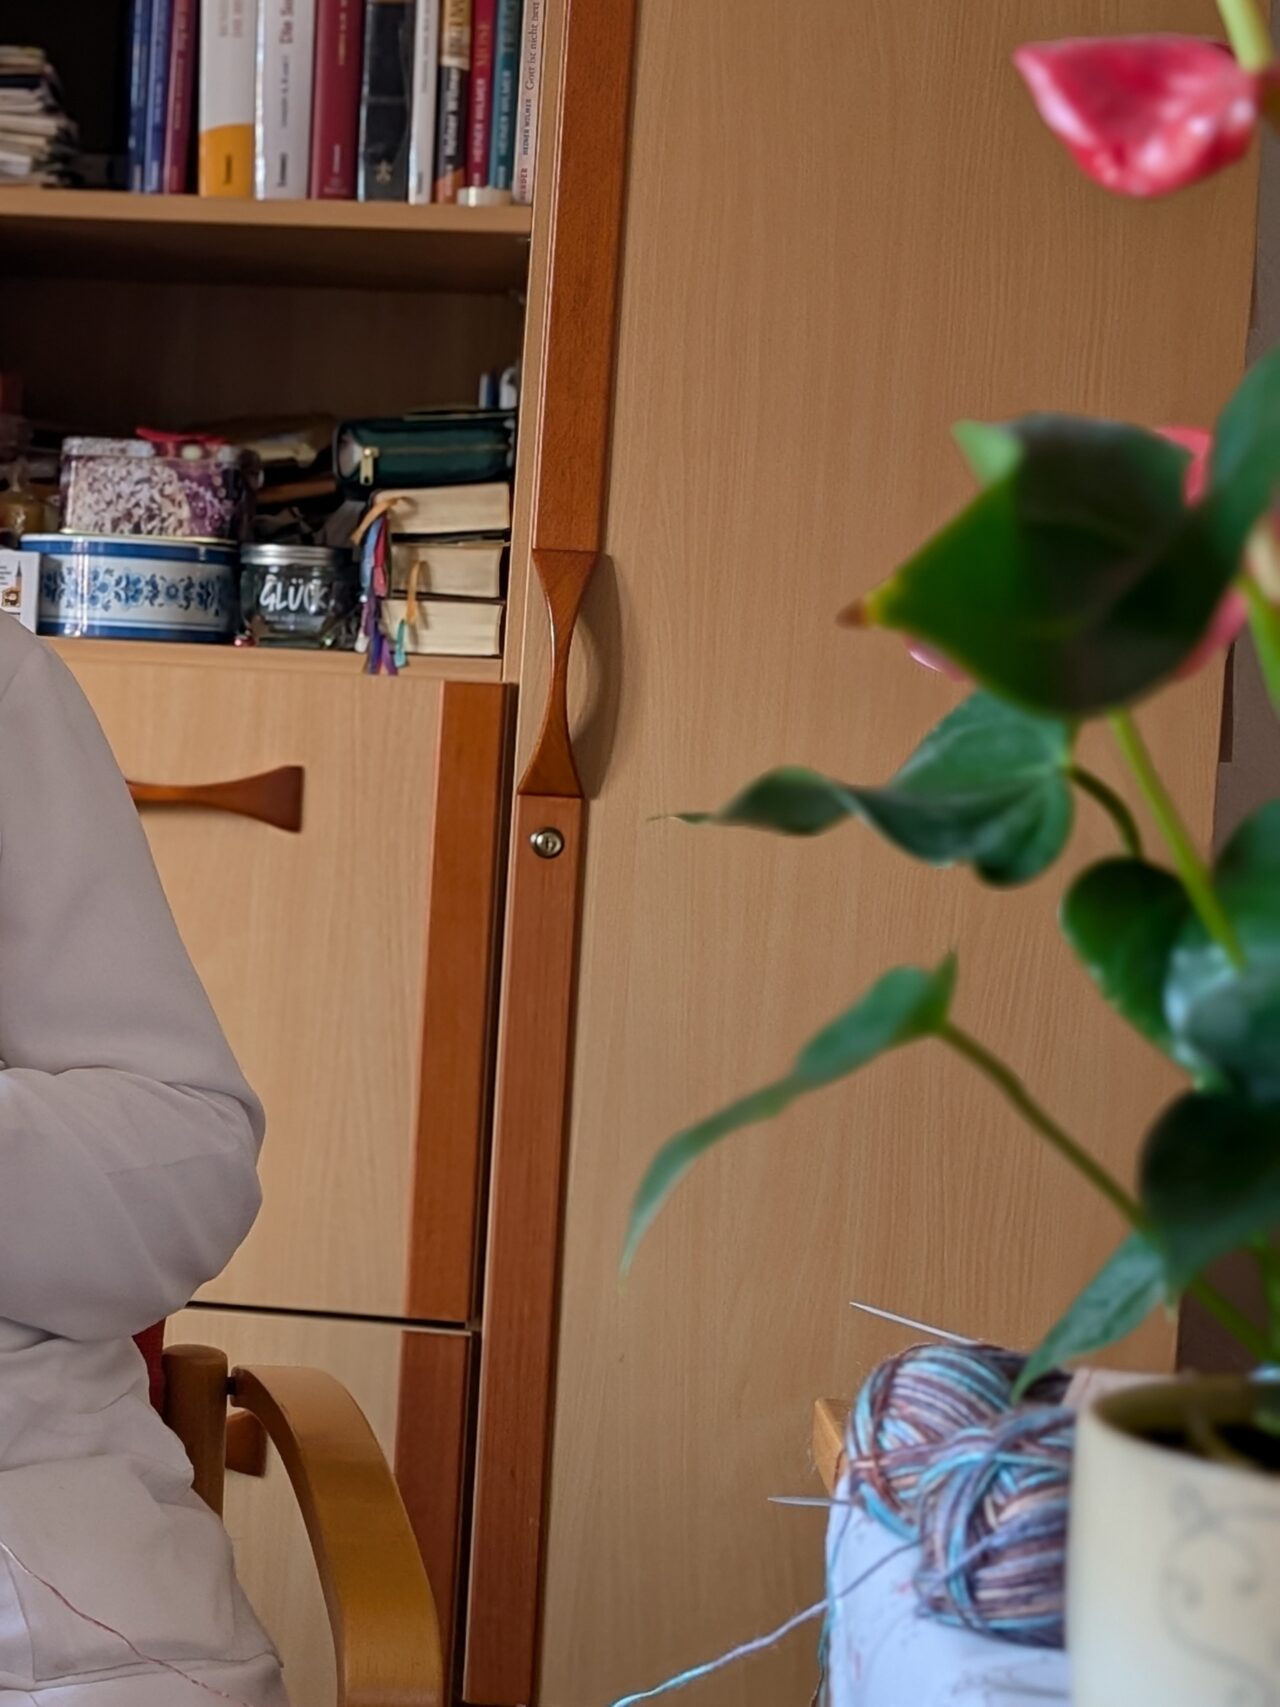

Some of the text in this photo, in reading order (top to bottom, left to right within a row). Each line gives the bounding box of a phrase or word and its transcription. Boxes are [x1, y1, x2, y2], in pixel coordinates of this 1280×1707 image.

[527, 24, 539, 50] nicht
[527, 53, 537, 64] ist
[524, 66, 537, 90] Gott
[259, 577, 329, 612] GLÜCK
